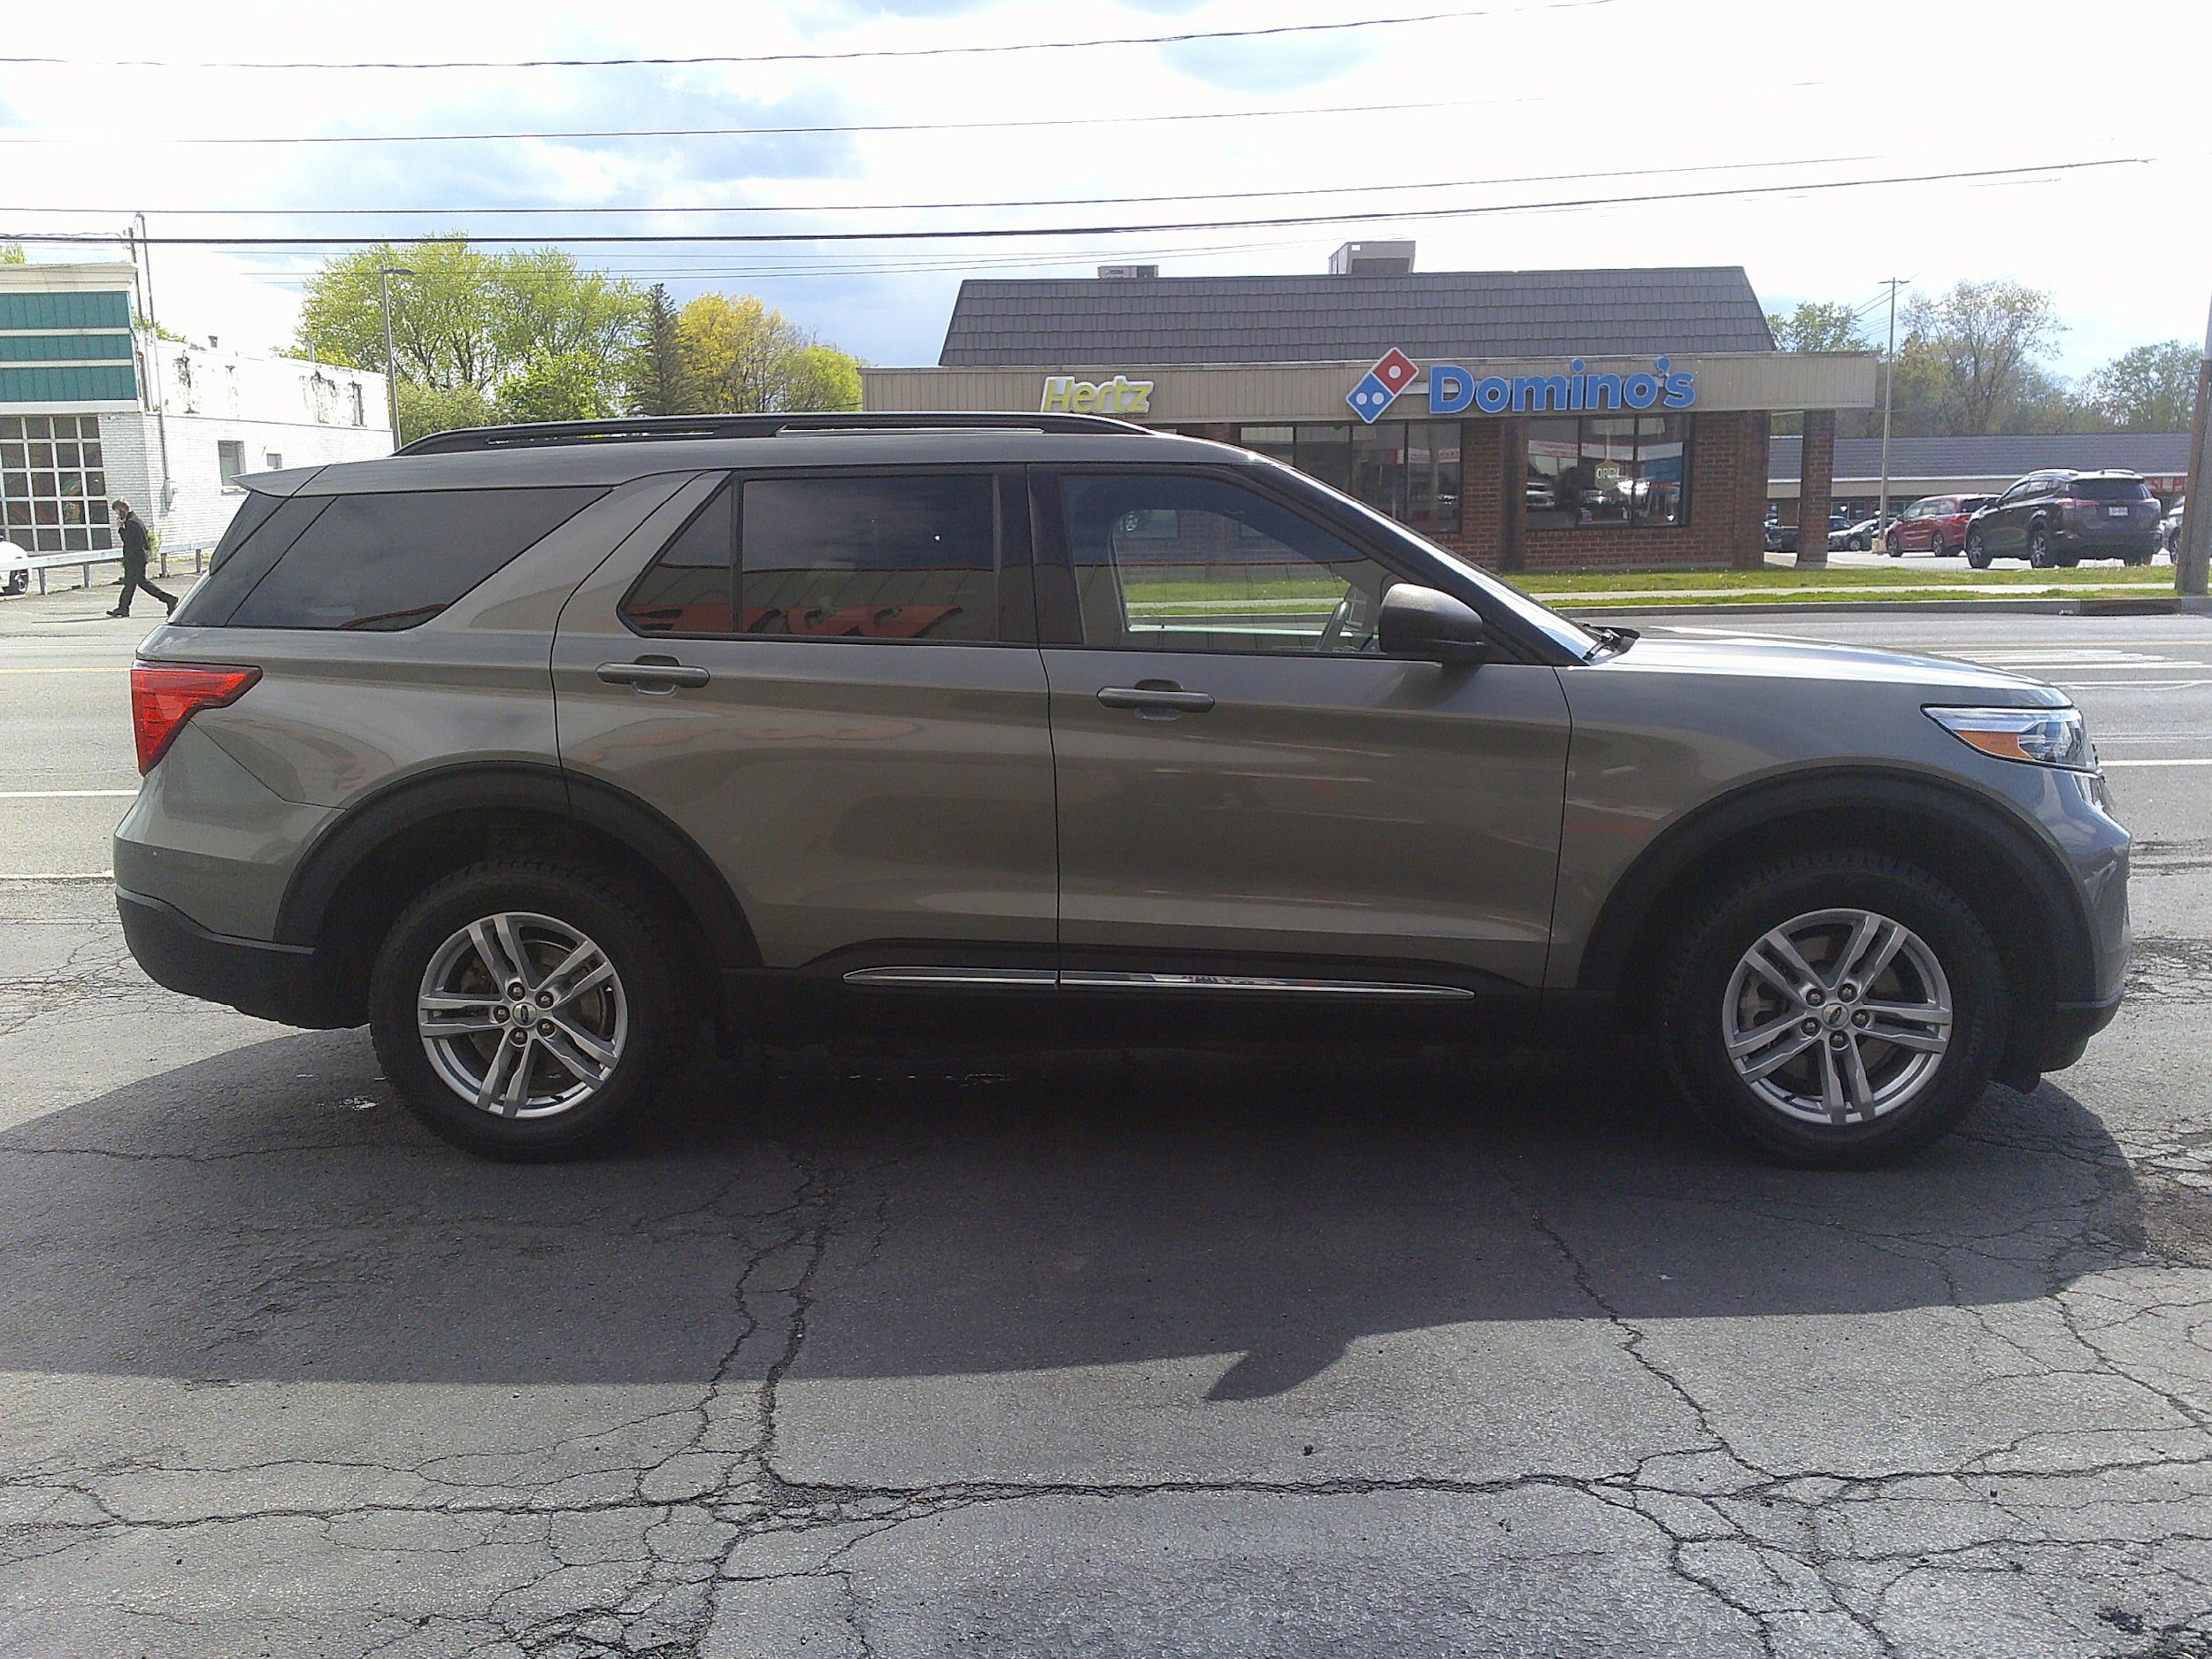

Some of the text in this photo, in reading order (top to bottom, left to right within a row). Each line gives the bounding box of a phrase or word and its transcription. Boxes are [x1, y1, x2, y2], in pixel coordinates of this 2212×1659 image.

[1041, 376, 1153, 413] Hertz
[1428, 356, 1696, 414] Domino's
[1596, 467, 1620, 479] OPEN
